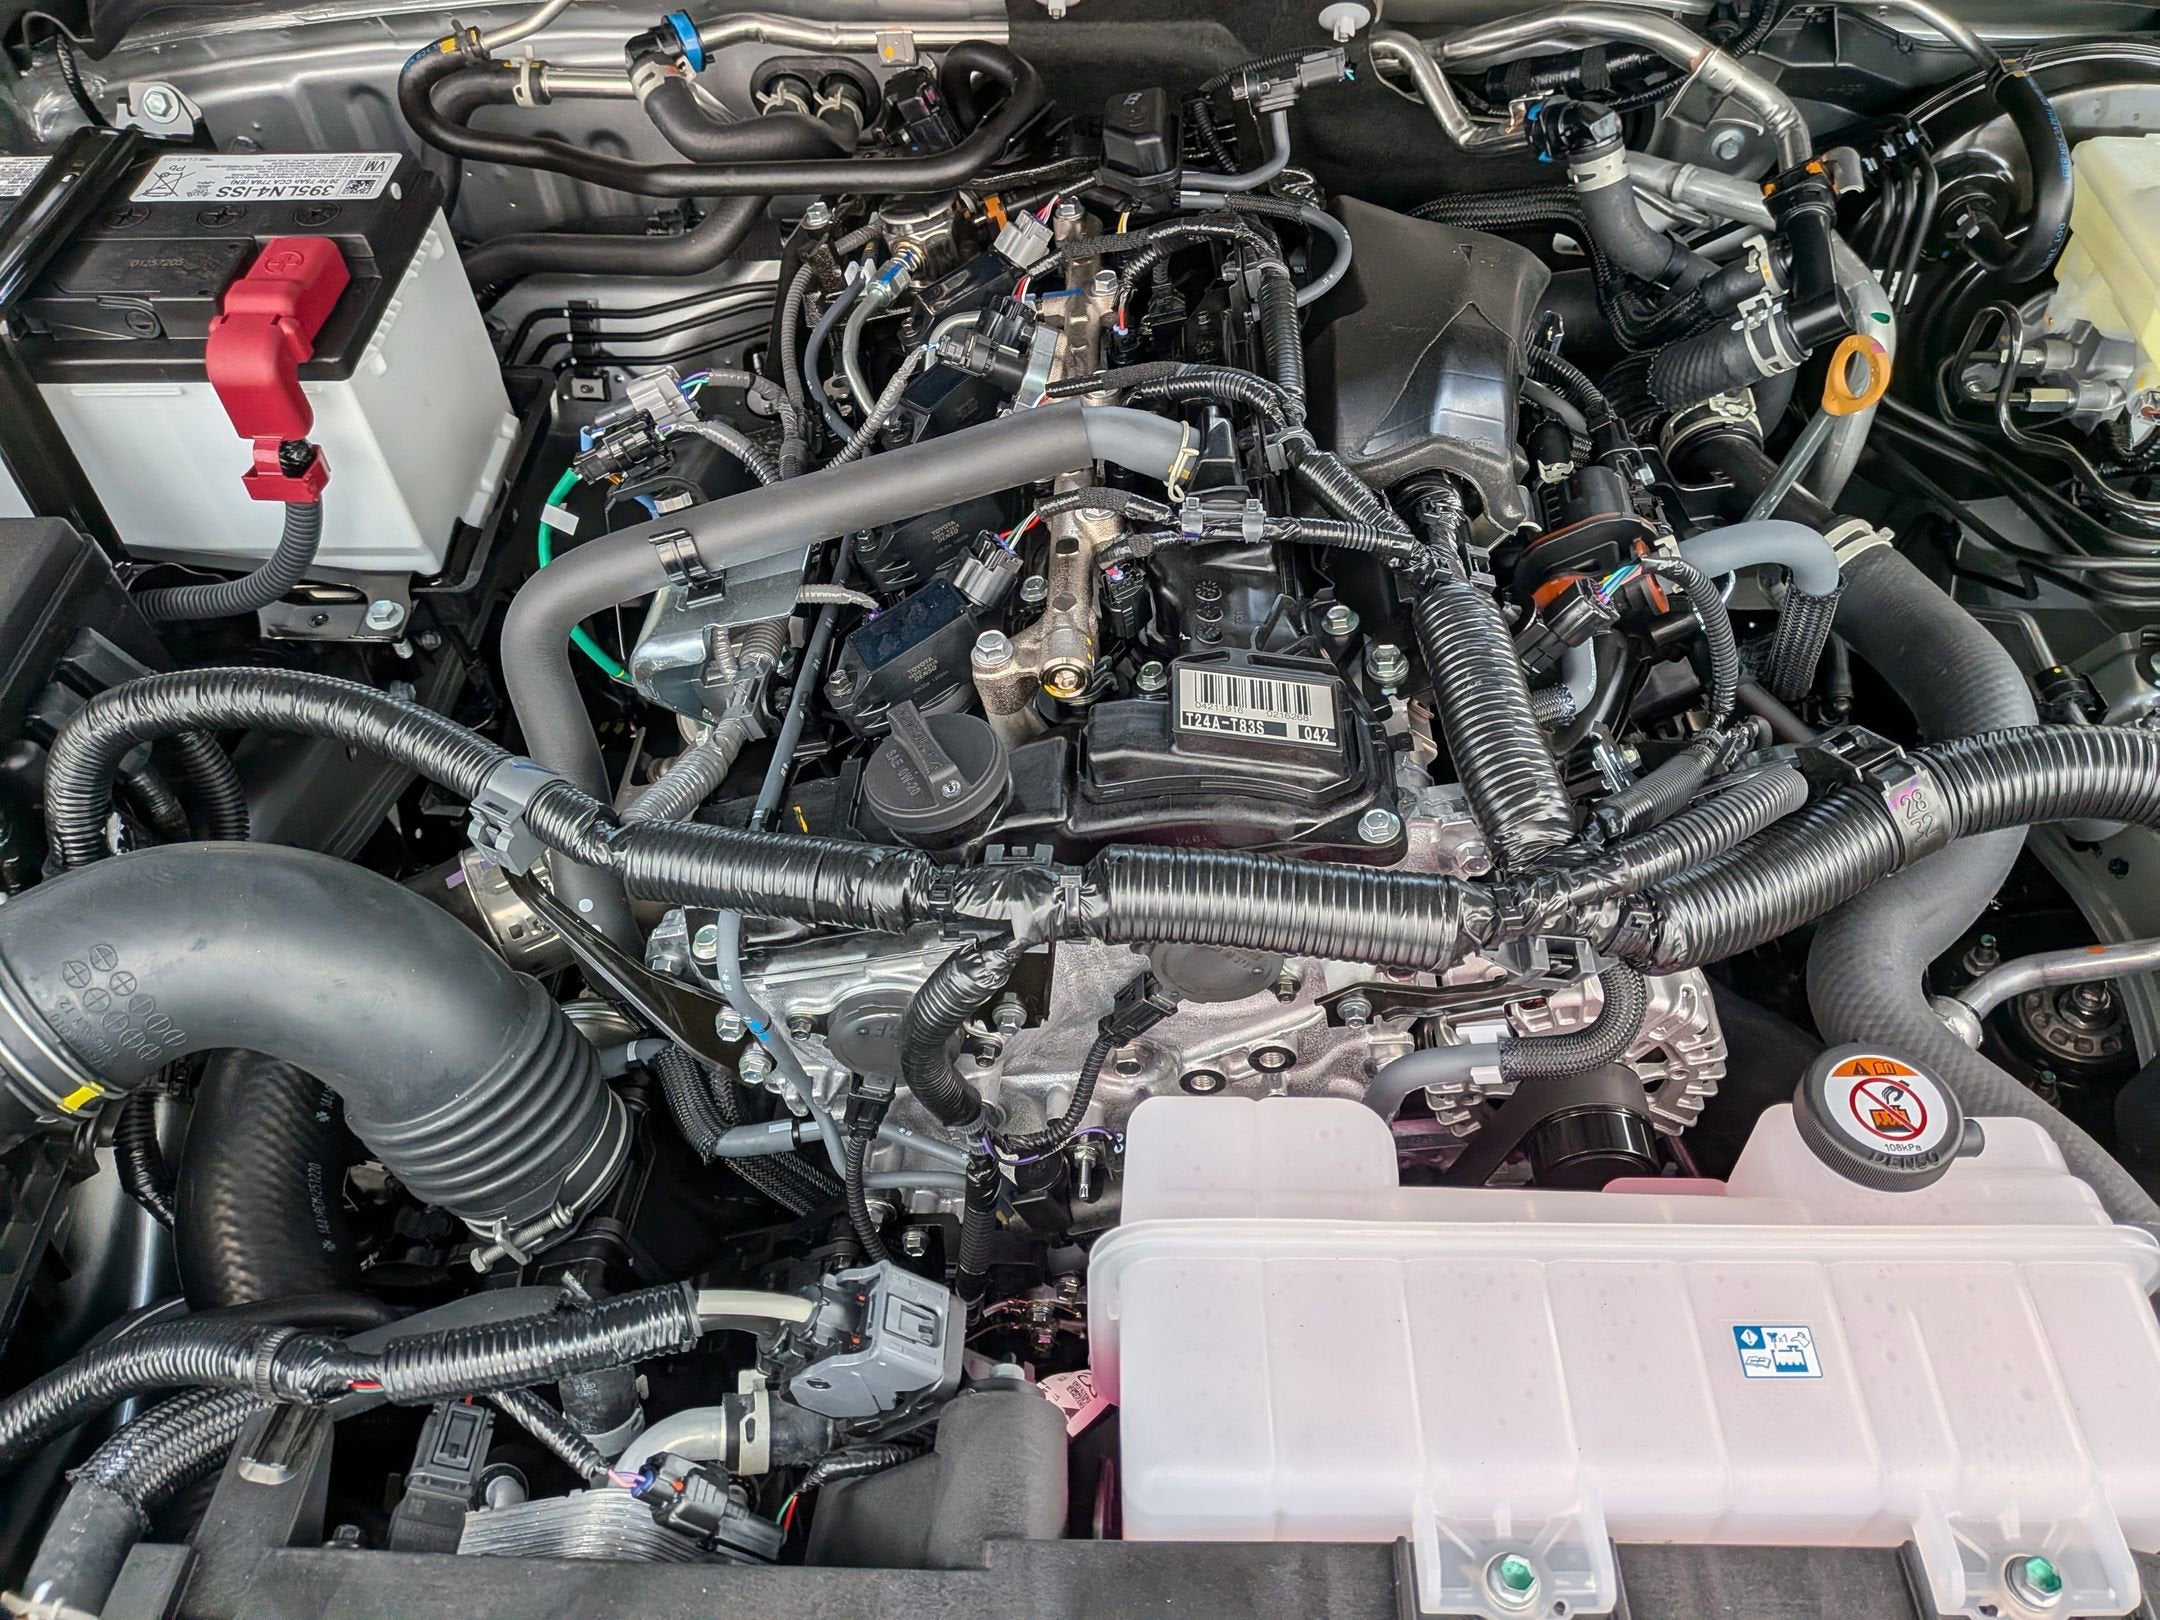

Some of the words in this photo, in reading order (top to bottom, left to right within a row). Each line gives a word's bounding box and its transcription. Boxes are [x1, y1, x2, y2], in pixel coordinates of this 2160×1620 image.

[364, 161, 386, 172] VM
[216, 185, 335, 198] 395LN4-ISS
[931, 520, 956, 536] TOYOTA
[906, 656, 934, 674] TOYOTA
[914, 664, 937, 682] DENSO
[1266, 710, 1310, 722] 0216268
[1185, 712, 1265, 735] T24A-T83S
[1304, 726, 1330, 742] 042
[885, 749, 903, 771] SAE
[897, 767, 922, 797] 0W-20
[1900, 788, 1927, 821] 28
[1884, 1142, 1922, 1153] 108kPa
[1870, 1150, 1941, 1170] DENSO
